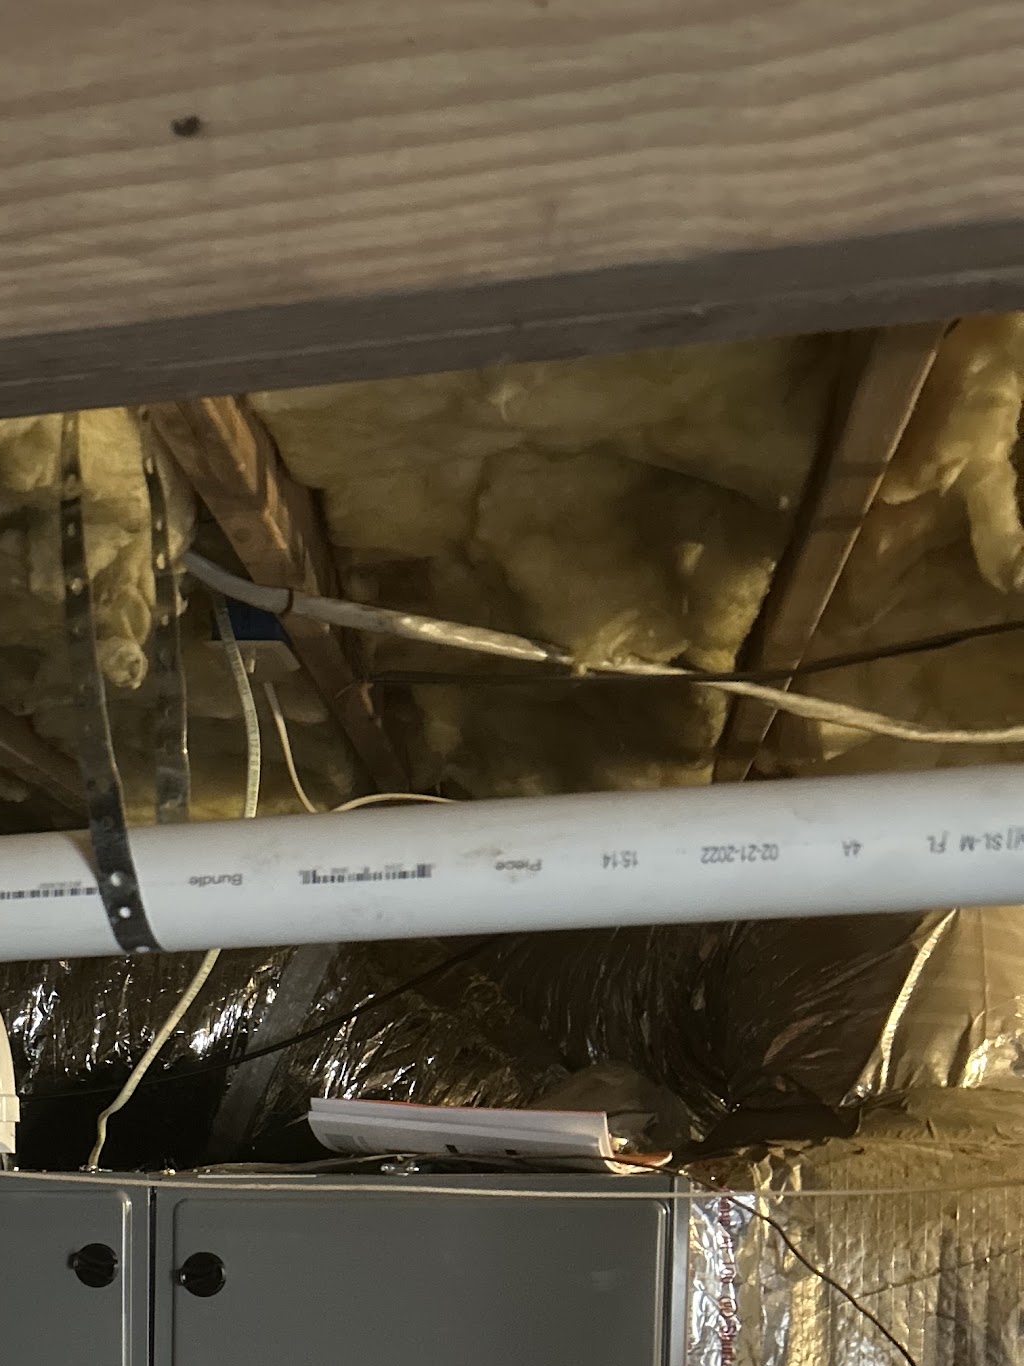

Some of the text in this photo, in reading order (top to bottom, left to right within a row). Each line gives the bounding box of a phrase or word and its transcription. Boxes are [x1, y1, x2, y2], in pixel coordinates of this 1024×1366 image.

[700, 843, 779, 865] 02-21-2022
[495, 858, 543, 872] Piece
[188, 869, 243, 886] Bundle
